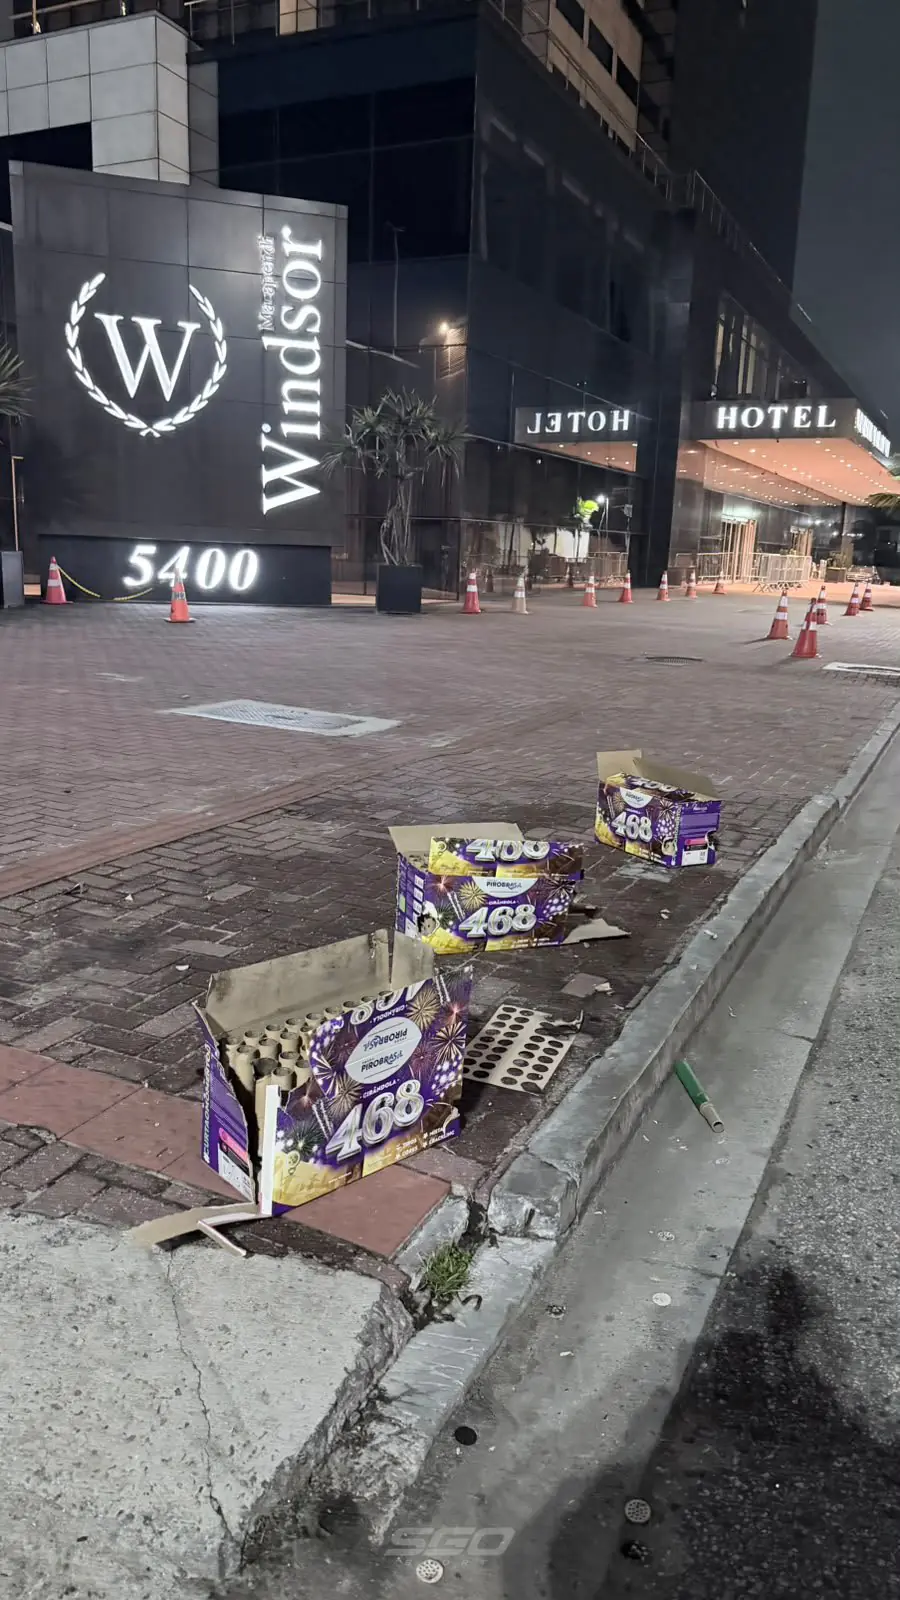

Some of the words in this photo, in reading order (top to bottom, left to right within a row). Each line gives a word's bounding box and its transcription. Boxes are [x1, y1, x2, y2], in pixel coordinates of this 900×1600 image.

[94, 312, 201, 402] W
[262, 224, 324, 515] Windsor
[716, 404, 837, 431] HOTEL
[122, 543, 260, 591] 5400
[458, 903, 537, 940] 468
[325, 1079, 425, 1162] 468
